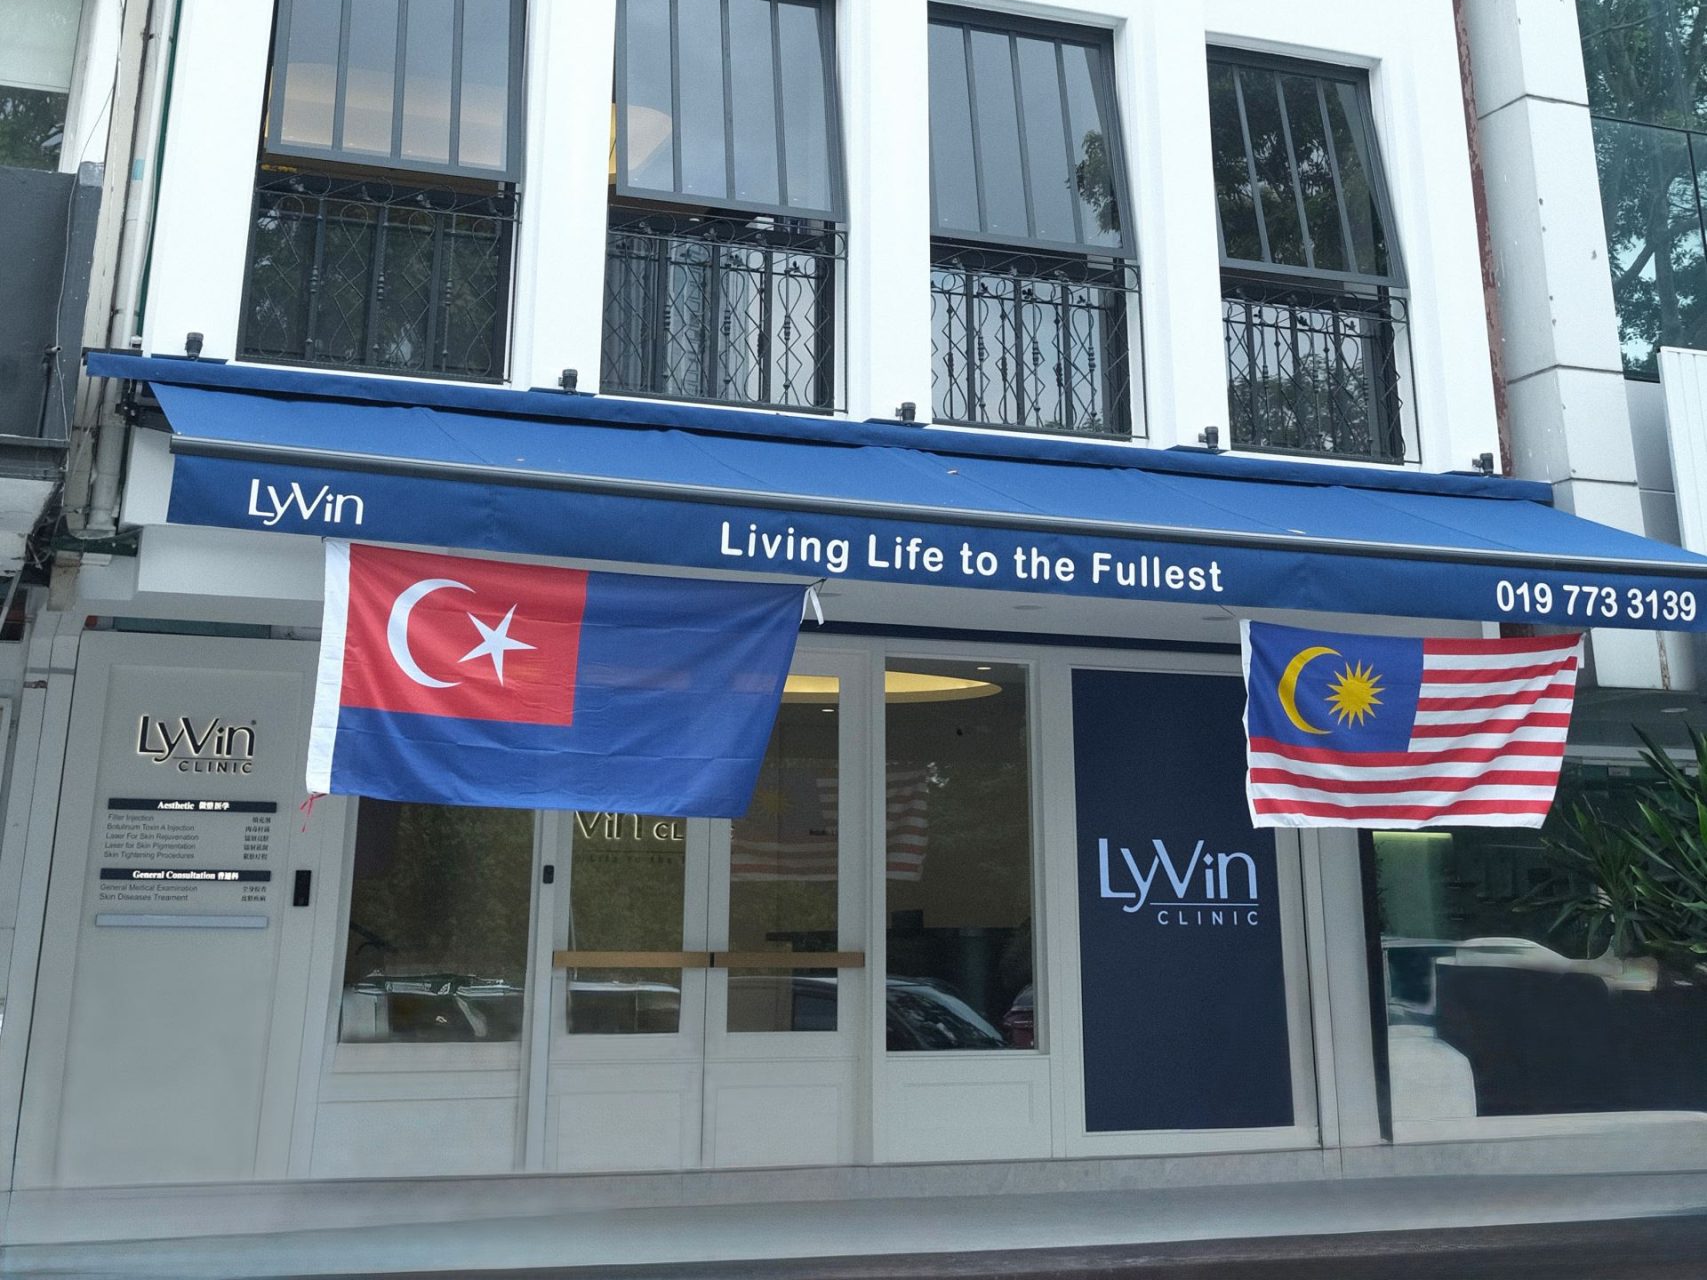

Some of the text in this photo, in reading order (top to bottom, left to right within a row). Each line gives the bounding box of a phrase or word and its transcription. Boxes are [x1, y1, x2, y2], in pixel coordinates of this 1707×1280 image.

[248, 478, 364, 526] LyVin
[720, 520, 1224, 593] Living Life to the Fullest
[1496, 580, 1697, 622] 019 773 3139
[177, 759, 253, 775] CLINIC
[157, 801, 195, 811] Aesthetic
[167, 824, 195, 833] Injection
[575, 809, 643, 841] Vin
[156, 851, 195, 859] Procedures
[132, 870, 216, 880] General Consultation
[1098, 837, 1258, 913] LyVin
[99, 883, 127, 891] General
[156, 884, 198, 892] Examination
[99, 893, 116, 901] Skin
[117, 893, 152, 901] Diseases
[1157, 910, 1259, 926] CLINIC
